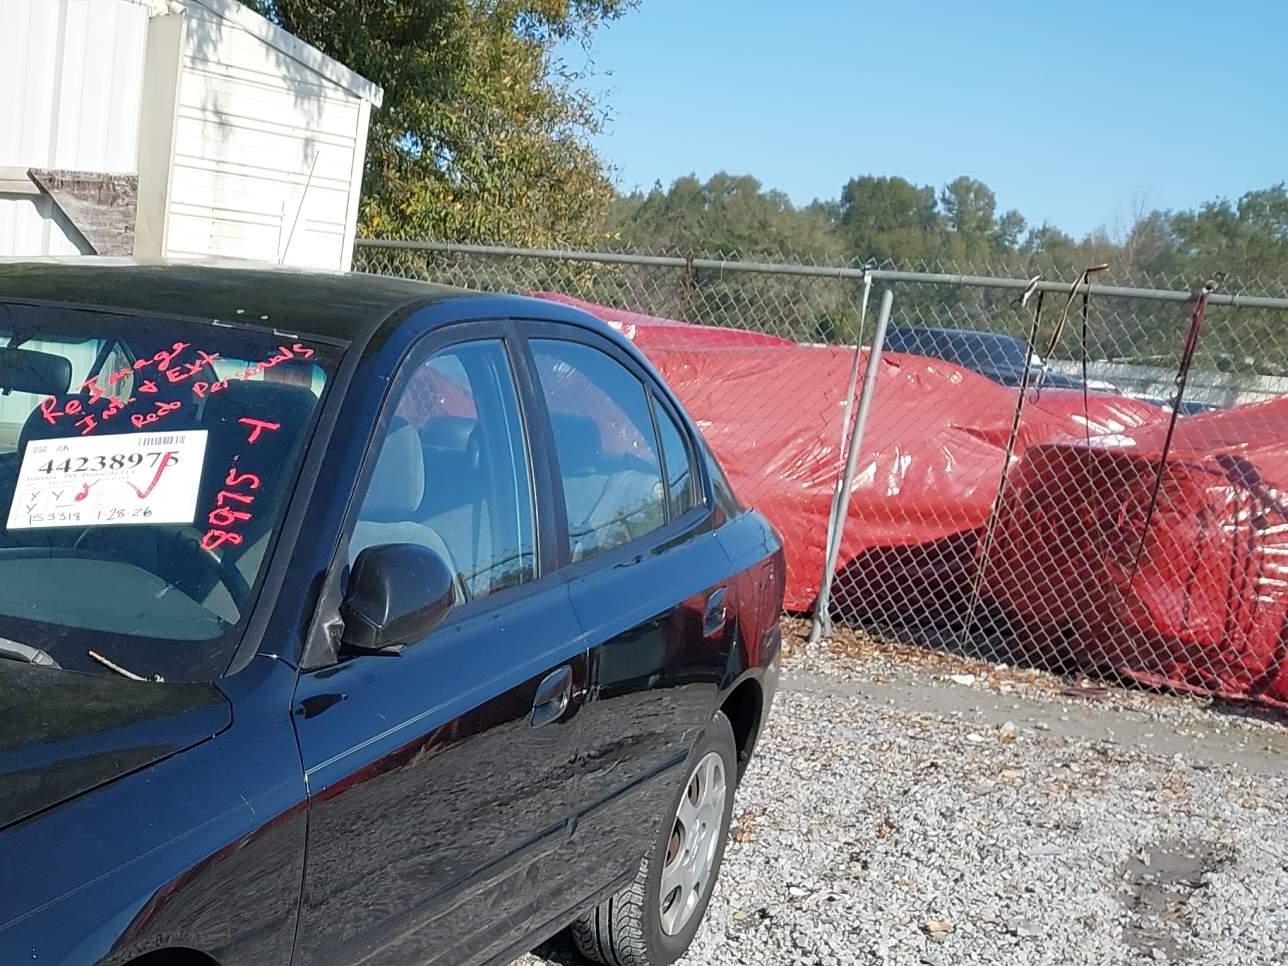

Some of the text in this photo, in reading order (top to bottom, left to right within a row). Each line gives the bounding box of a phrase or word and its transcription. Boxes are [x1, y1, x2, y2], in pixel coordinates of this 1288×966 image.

[166, 350, 221, 383] Ext
[192, 342, 314, 398] Personals
[38, 450, 180, 475] 44238975
